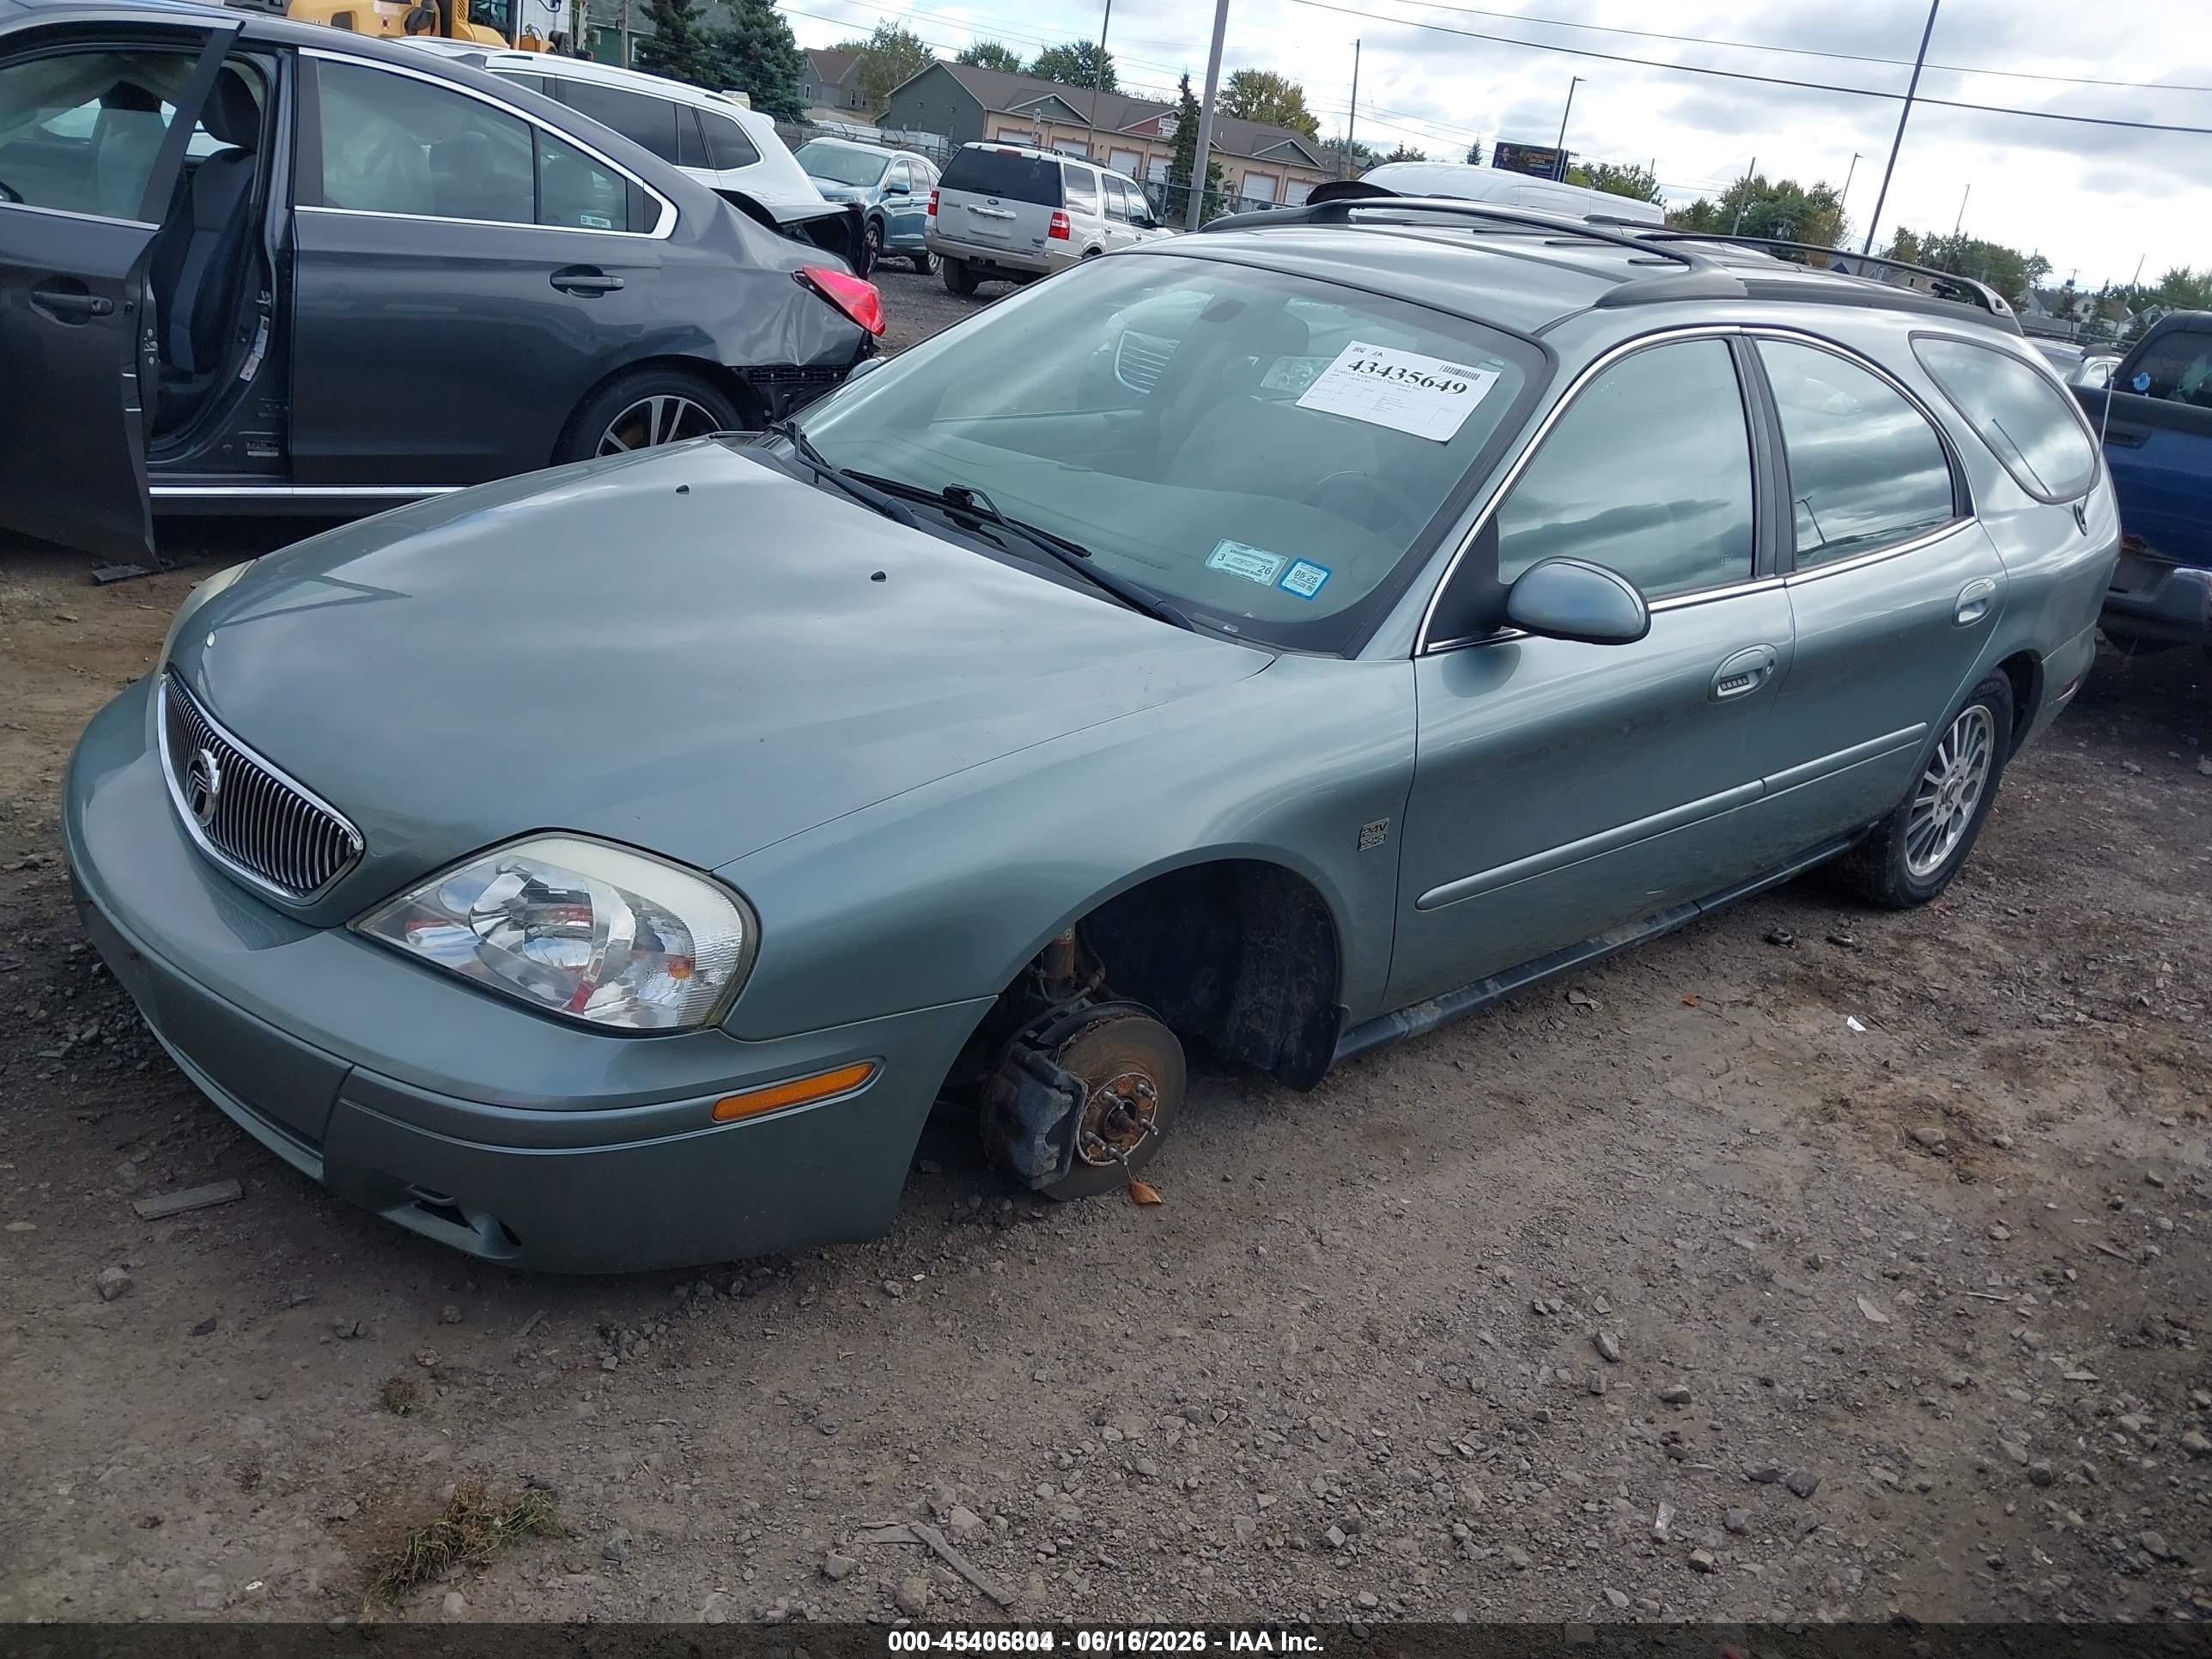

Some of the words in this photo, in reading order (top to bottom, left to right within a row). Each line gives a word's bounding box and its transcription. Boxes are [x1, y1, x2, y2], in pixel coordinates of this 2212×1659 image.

[1346, 359, 1468, 395] 43435649
[1256, 565, 1273, 574] 26
[1294, 569, 1306, 579] 05
[1362, 822, 1388, 837] 24V
